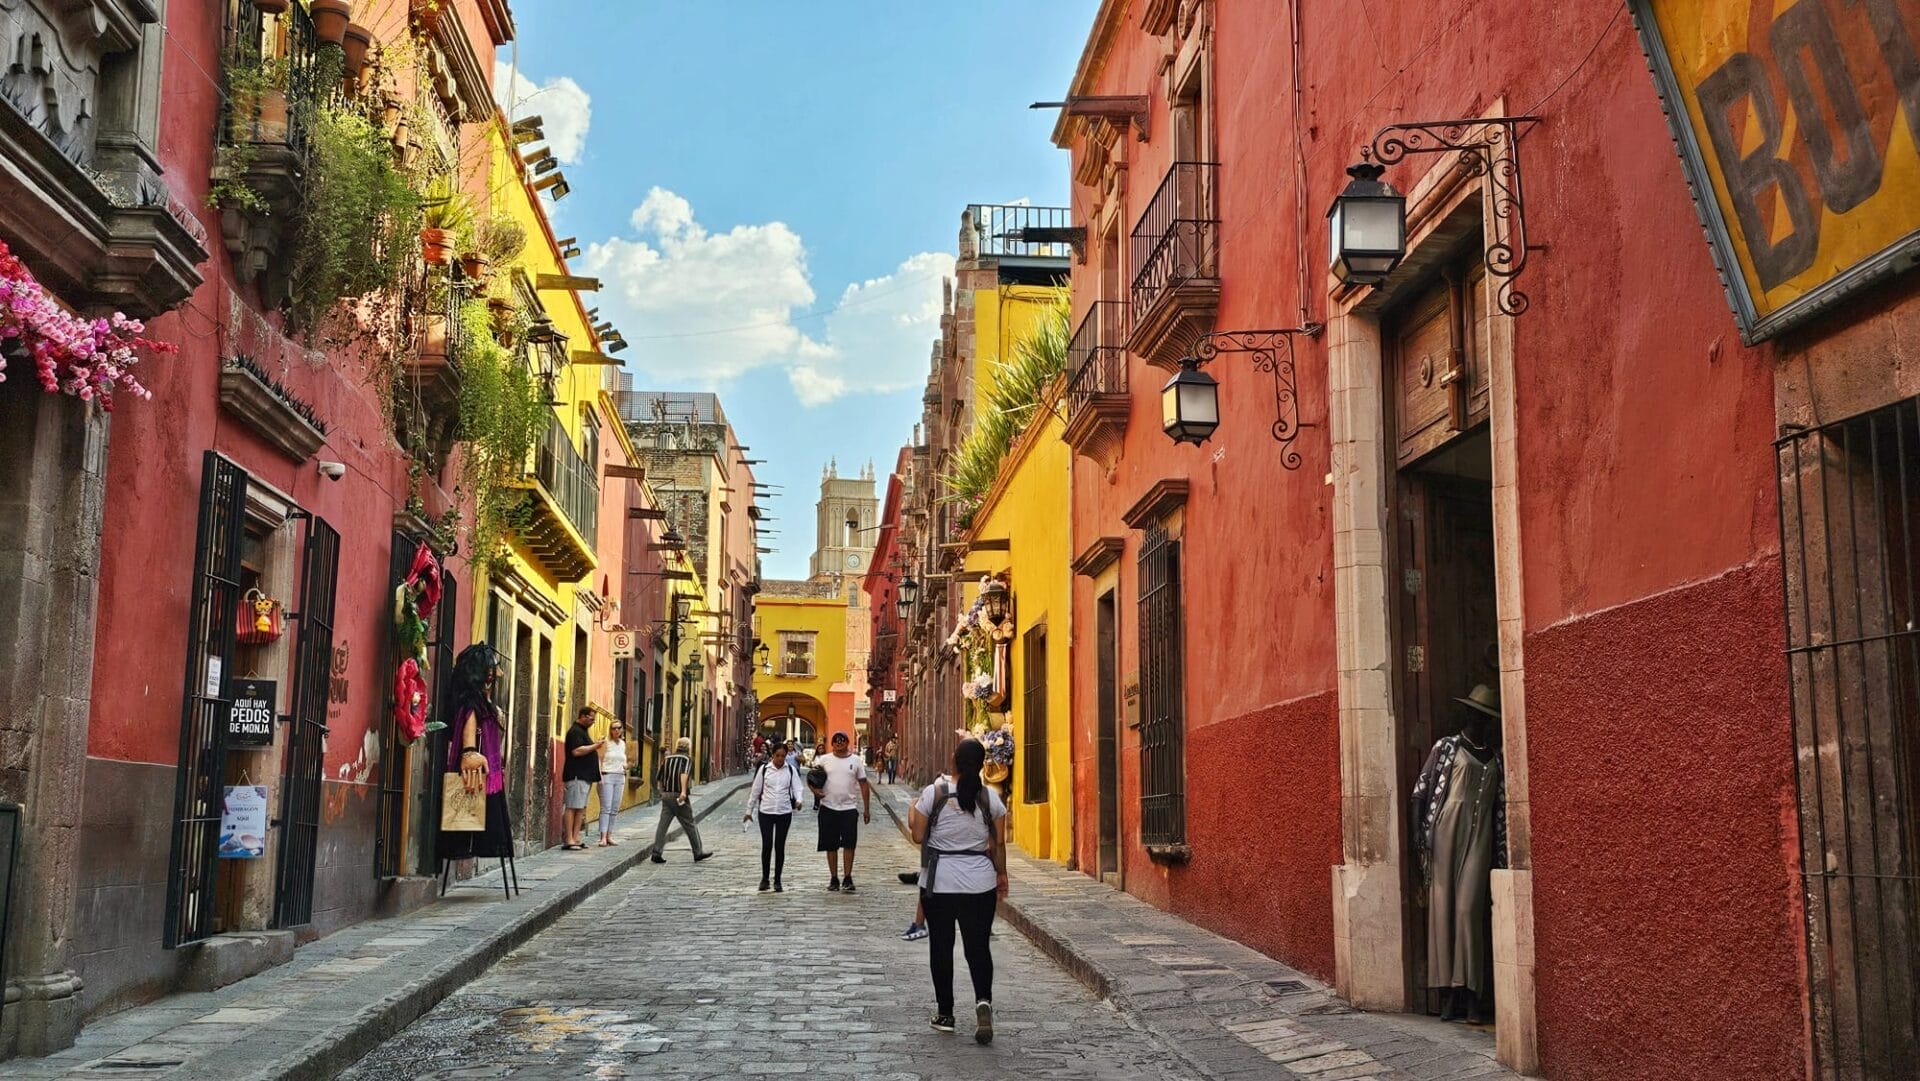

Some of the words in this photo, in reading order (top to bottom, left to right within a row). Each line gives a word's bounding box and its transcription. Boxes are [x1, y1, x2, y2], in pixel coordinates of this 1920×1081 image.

[234, 697, 252, 708] AQUÍ
[253, 699, 267, 709] HAY
[230, 707, 270, 723] PEDOS
[229, 722, 240, 733] DE
[241, 723, 270, 734] MONJA
